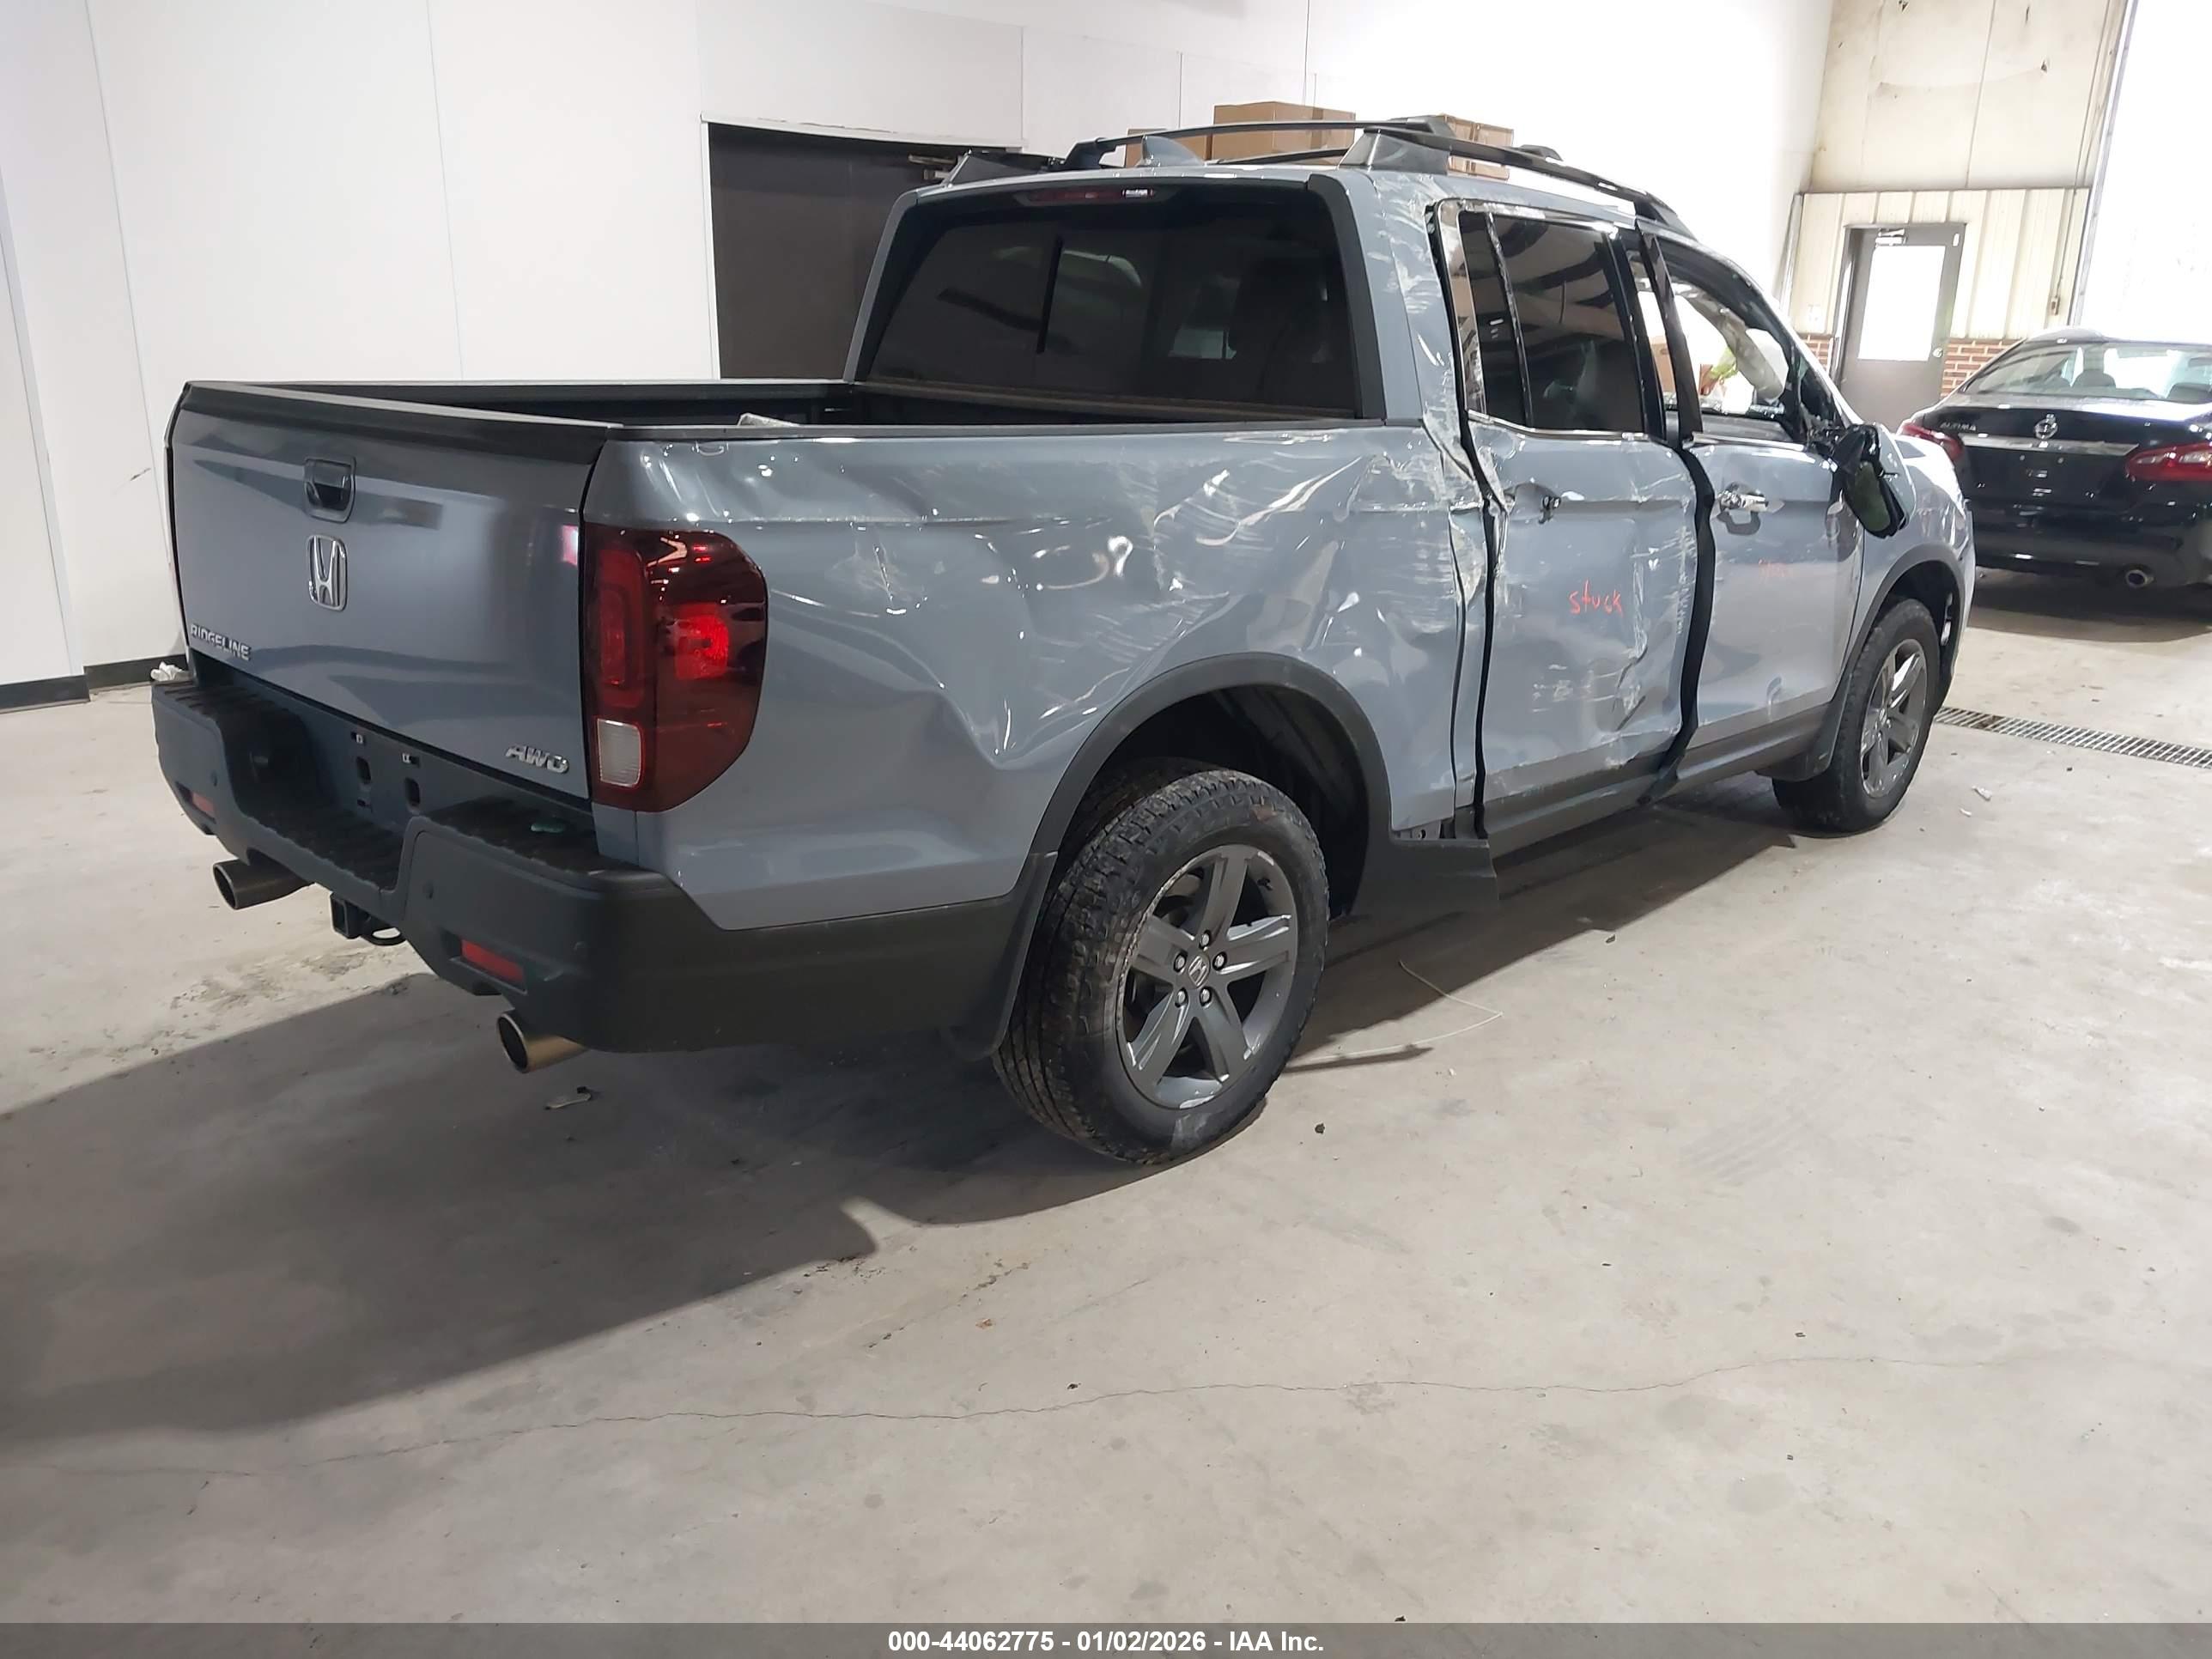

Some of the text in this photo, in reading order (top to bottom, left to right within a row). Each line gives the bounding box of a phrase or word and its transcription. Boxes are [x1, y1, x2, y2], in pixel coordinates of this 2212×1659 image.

[1569, 579, 1622, 615] stuck
[191, 624, 250, 660] RIDGELINE
[506, 745, 569, 774] AWD
